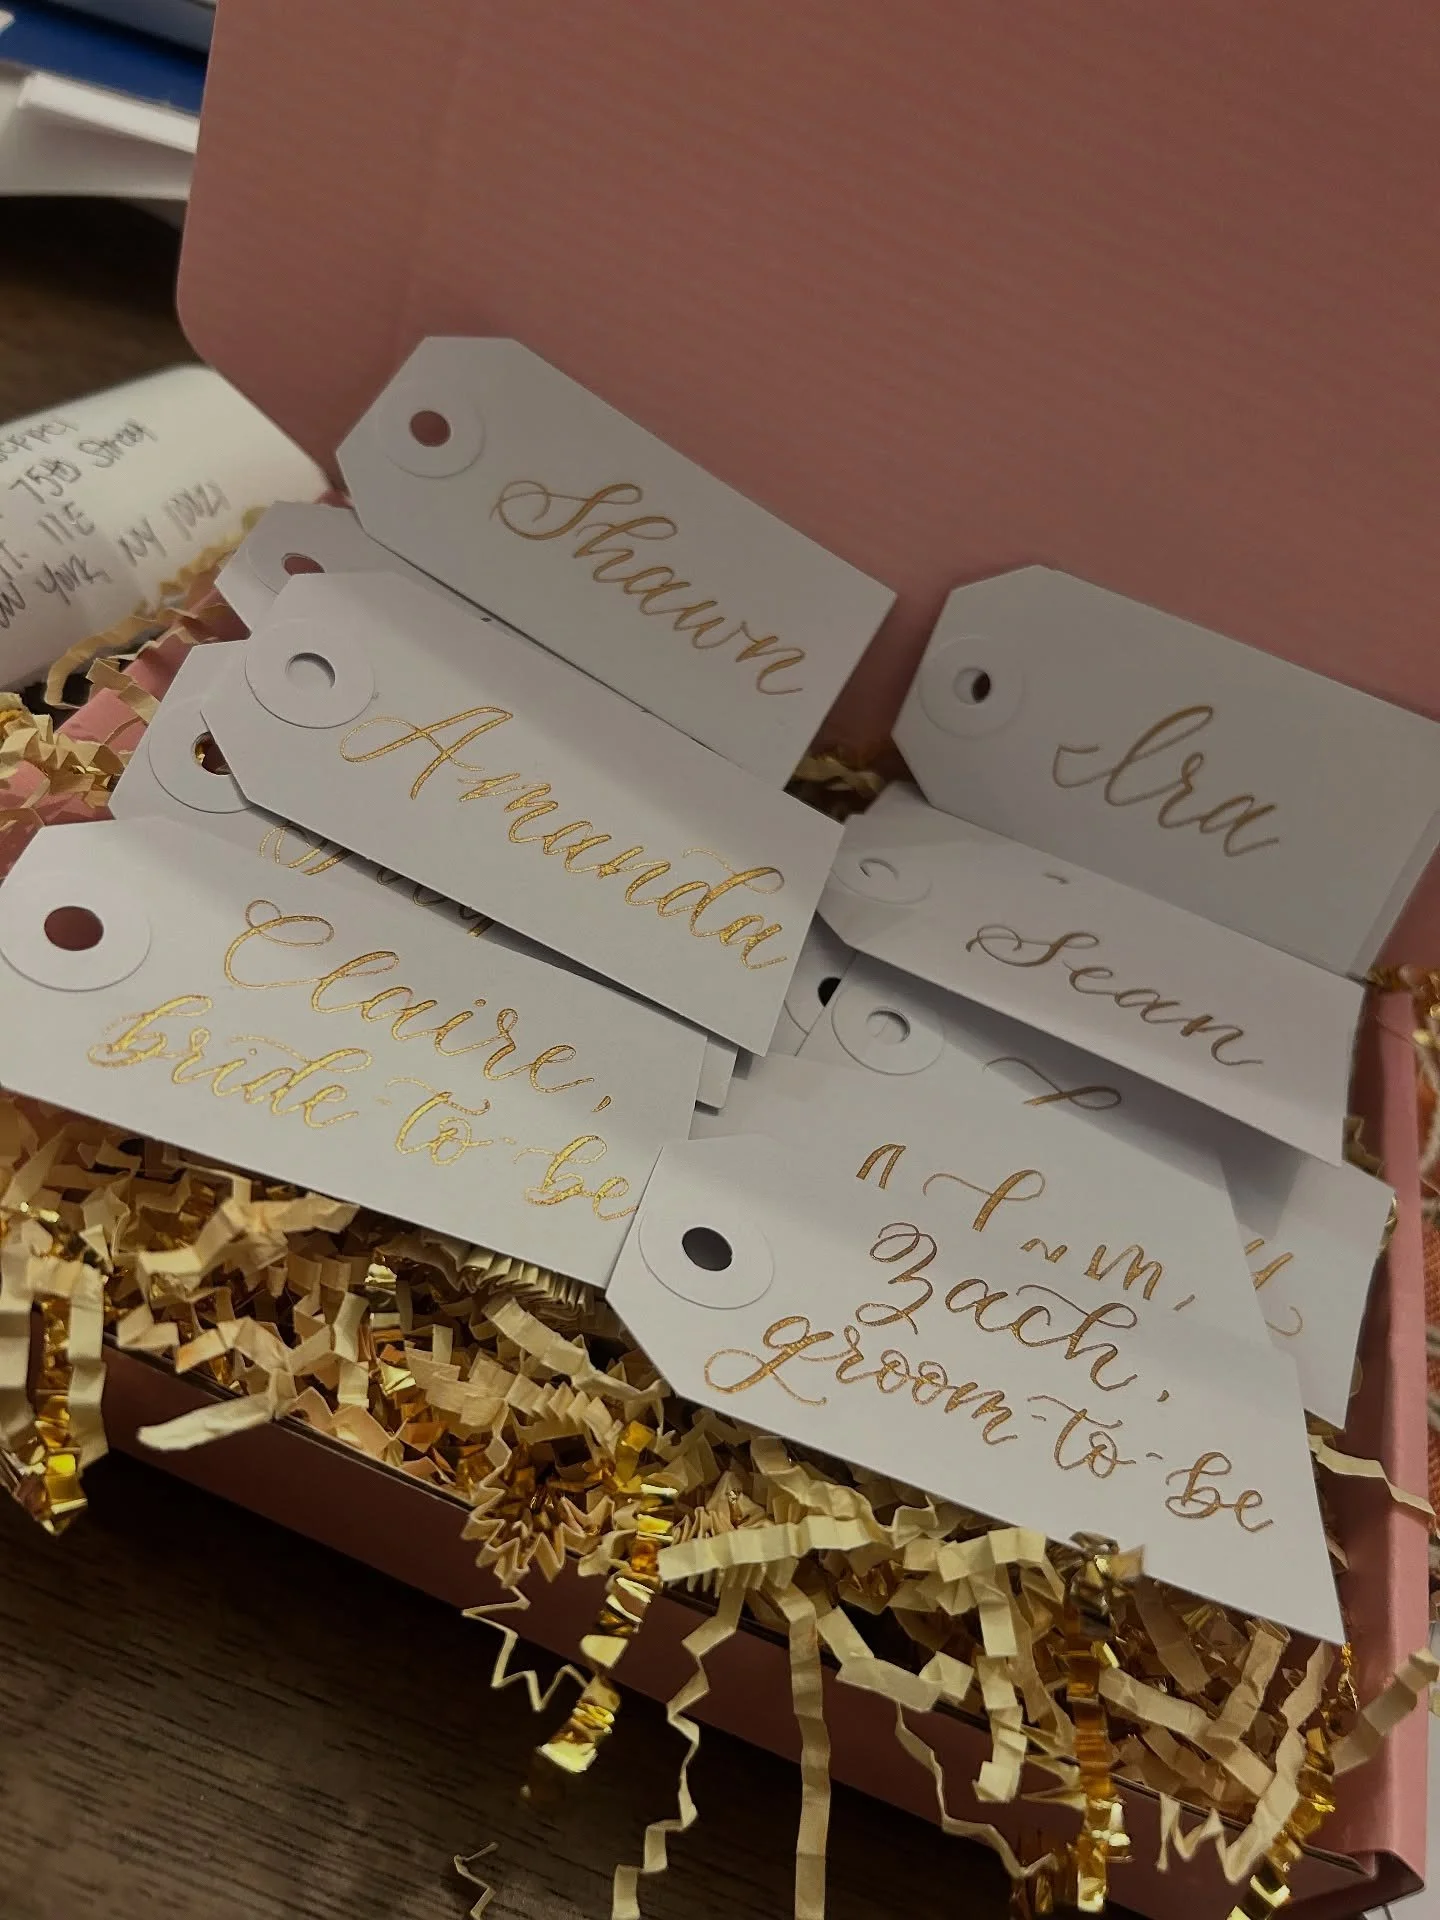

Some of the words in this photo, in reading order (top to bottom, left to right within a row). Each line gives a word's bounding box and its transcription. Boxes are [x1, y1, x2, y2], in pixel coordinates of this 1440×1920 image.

[490, 480, 806, 696] Shawn
[339, 705, 788, 970] Amanda
[1052, 704, 1280, 858] Ira
[965, 924, 1264, 1066] Sean
